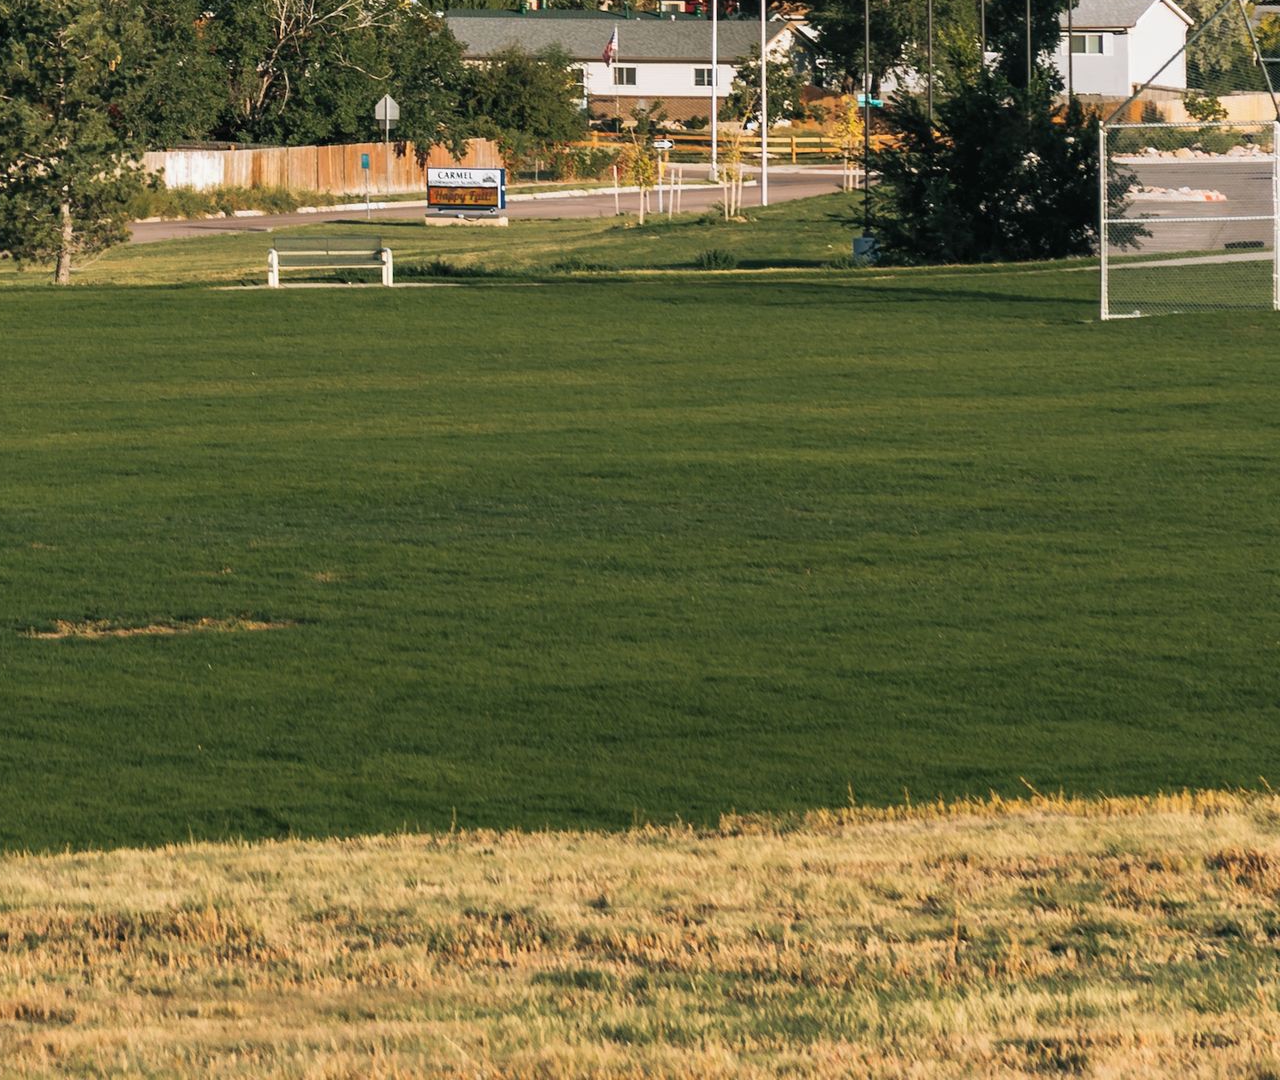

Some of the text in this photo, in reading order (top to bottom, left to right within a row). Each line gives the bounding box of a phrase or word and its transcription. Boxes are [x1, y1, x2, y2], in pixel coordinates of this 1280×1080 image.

[437, 171, 473, 179] CARMEL
[435, 189, 493, 203] Happy Fall!
